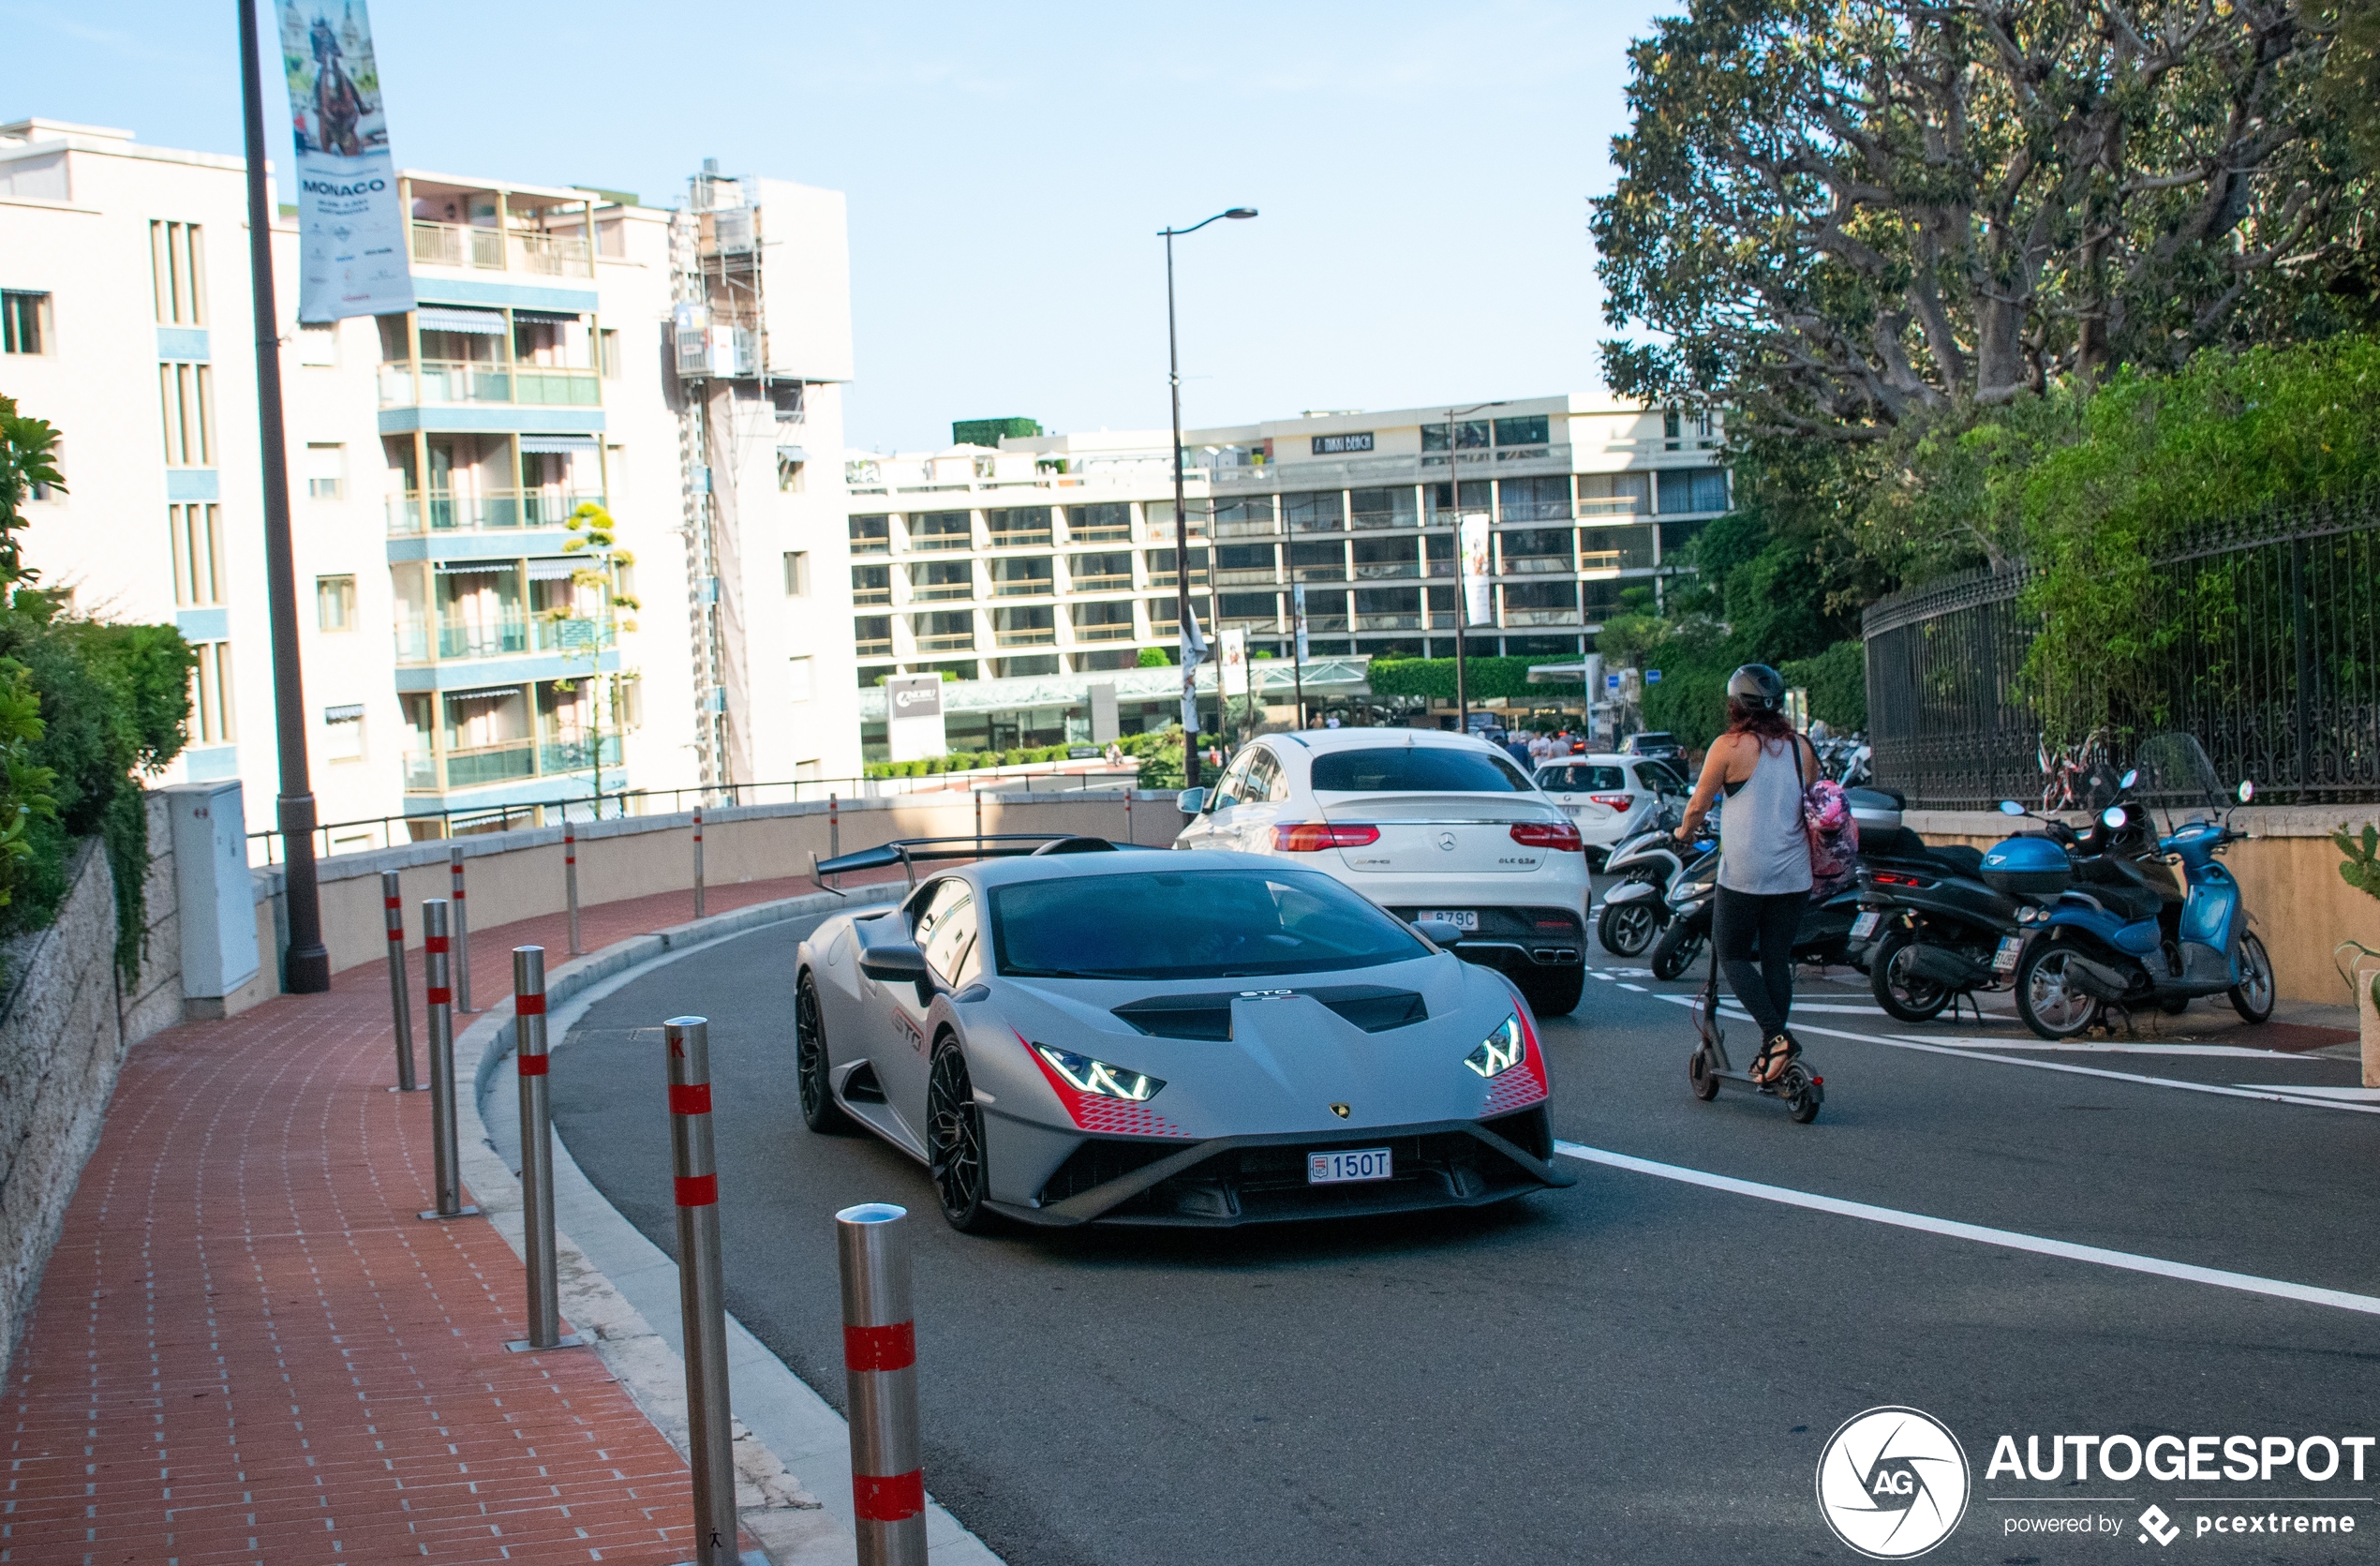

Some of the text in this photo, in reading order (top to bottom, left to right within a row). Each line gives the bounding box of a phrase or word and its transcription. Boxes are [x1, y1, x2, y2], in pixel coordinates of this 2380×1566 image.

[302, 178, 385, 197] MONACO
[893, 1014, 922, 1051] STO
[670, 1037, 685, 1058] K
[1333, 1153, 1387, 1178] 150T
